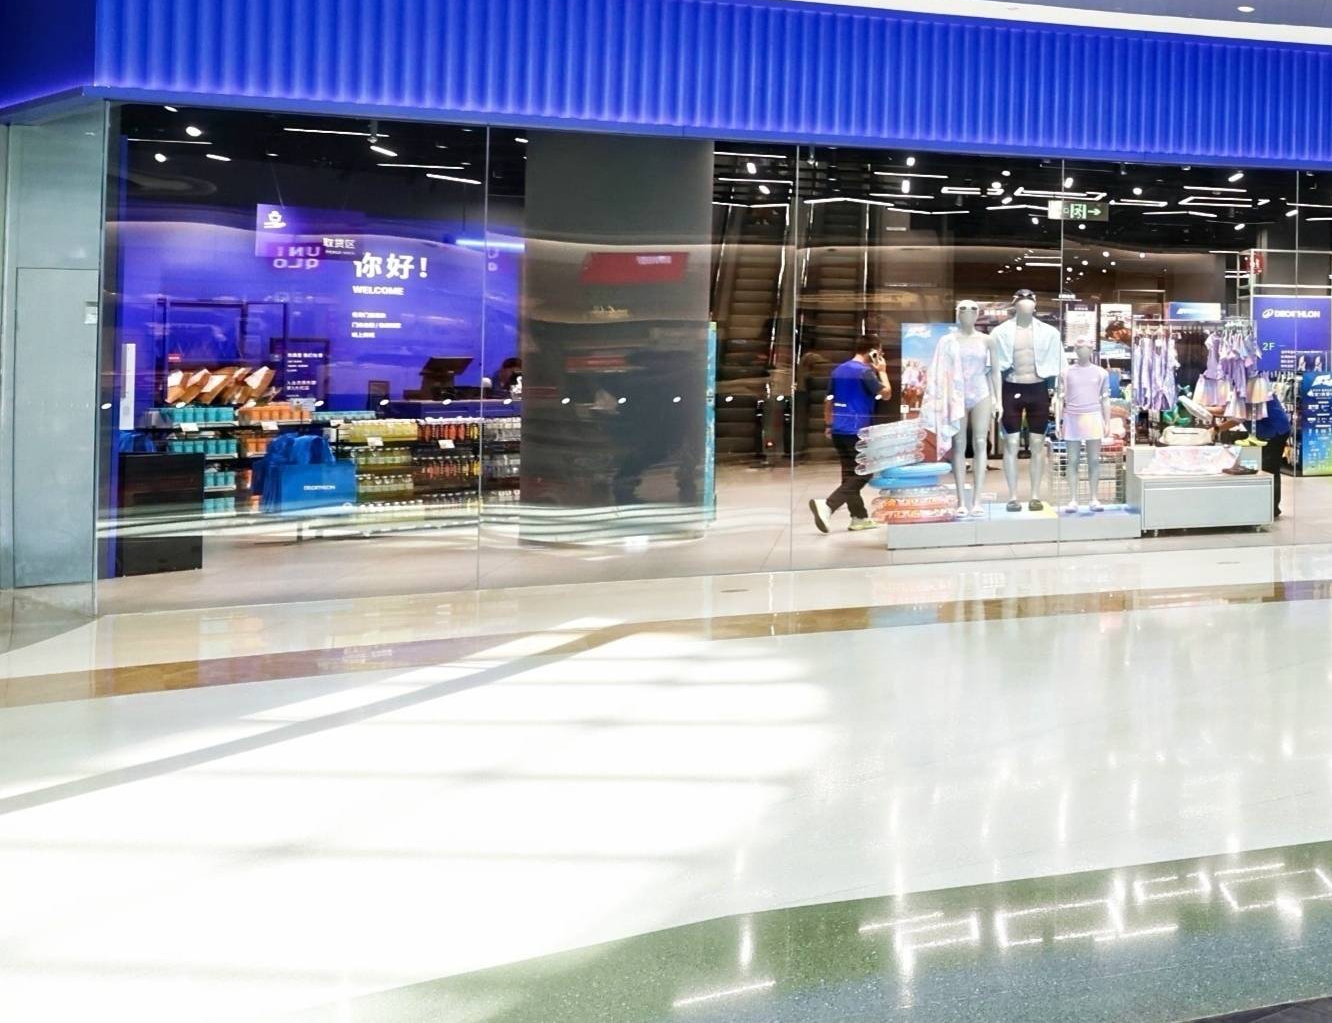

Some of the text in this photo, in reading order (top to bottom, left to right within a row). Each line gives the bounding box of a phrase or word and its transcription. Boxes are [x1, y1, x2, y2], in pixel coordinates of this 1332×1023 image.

[352, 286, 404, 295] WELCOME
[1274, 310, 1321, 318] DECATHLON
[1262, 342, 1275, 351] 2F
